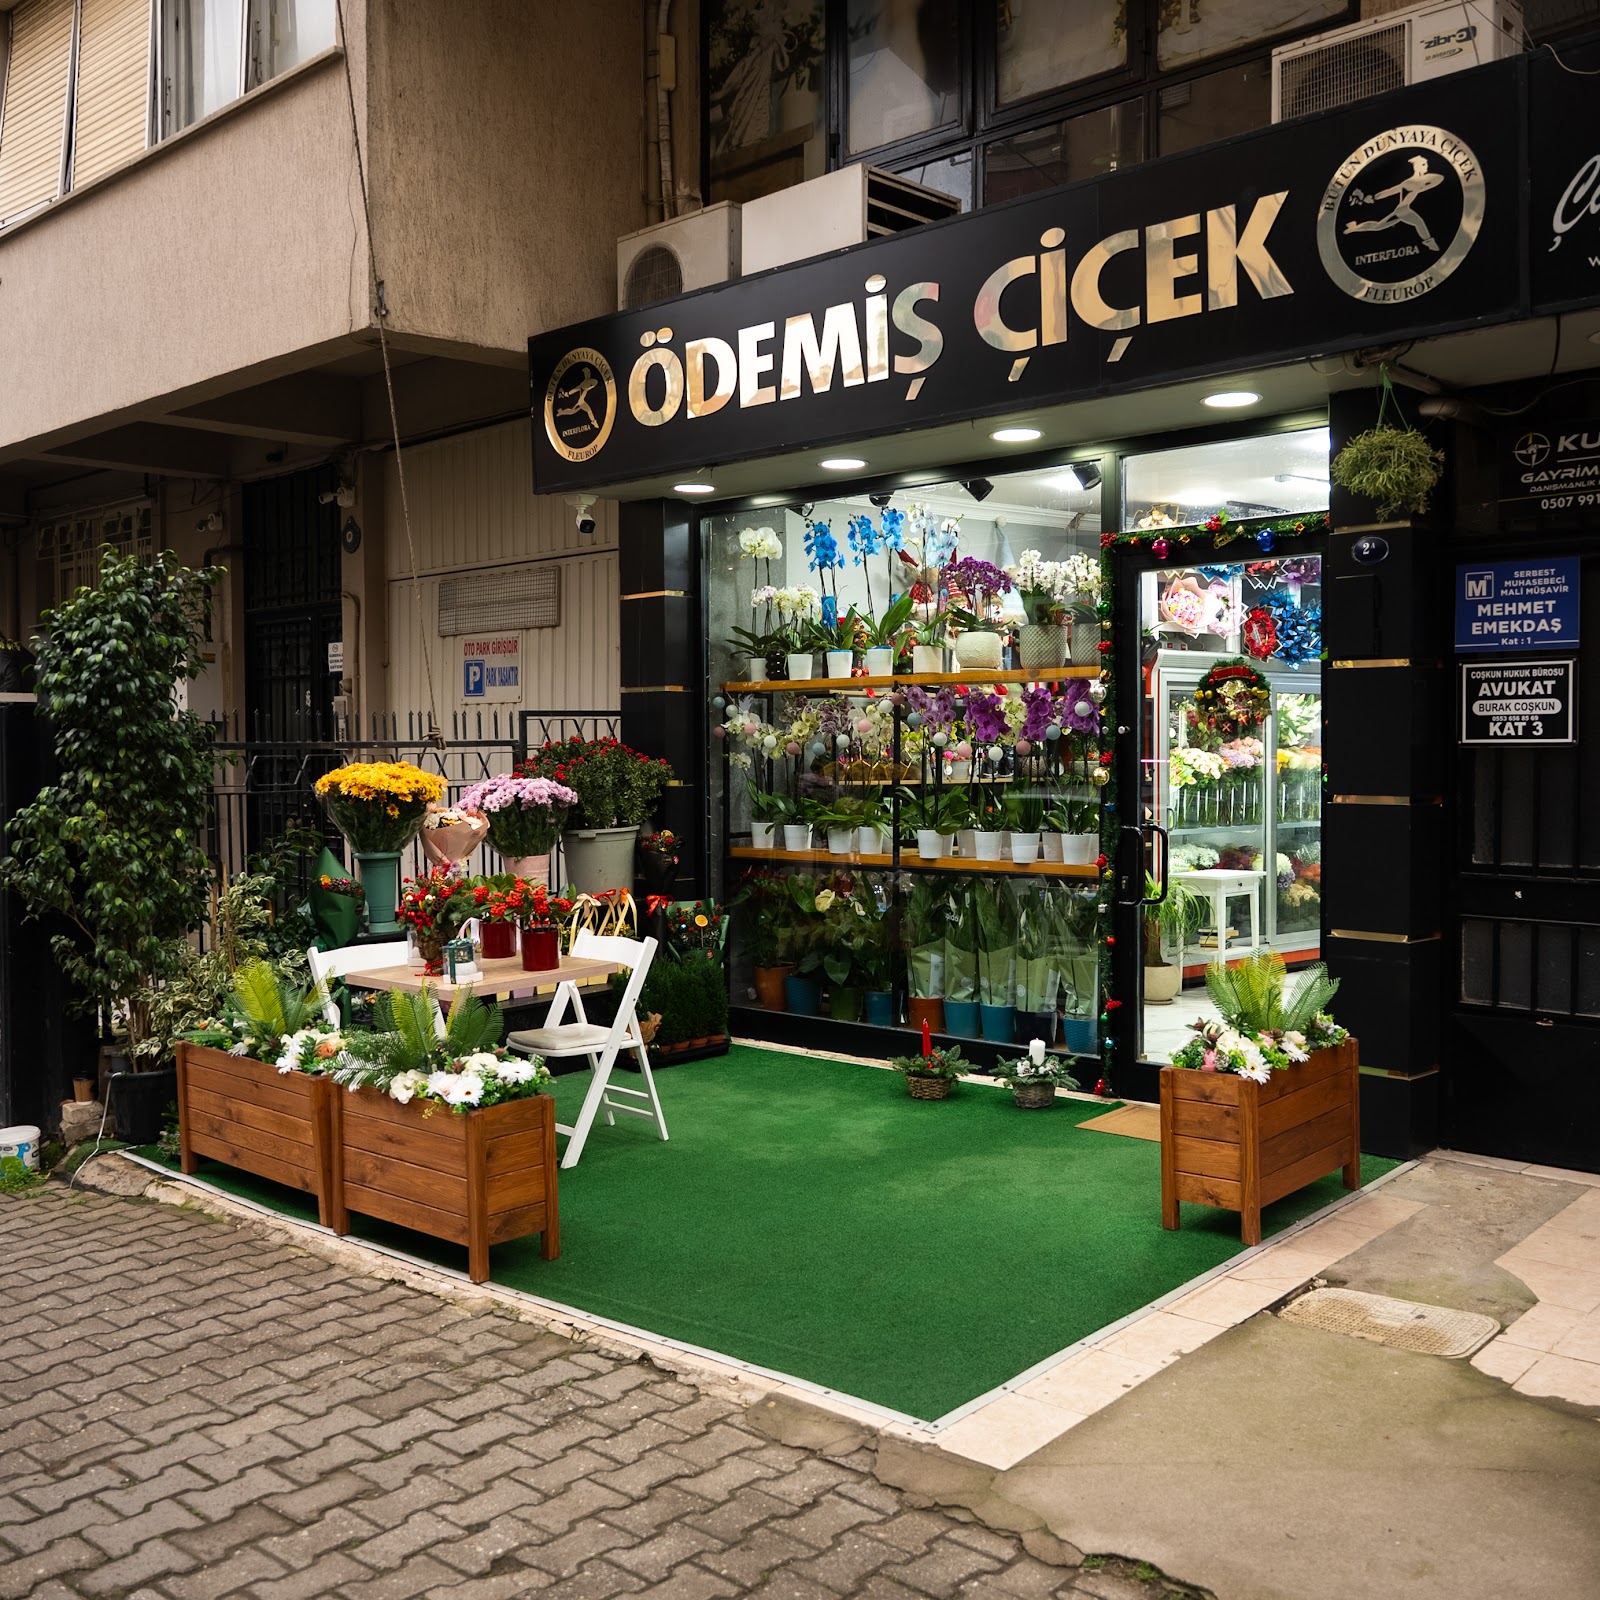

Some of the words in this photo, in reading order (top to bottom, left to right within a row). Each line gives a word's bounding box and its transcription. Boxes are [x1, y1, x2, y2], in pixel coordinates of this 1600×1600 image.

[1323, 156, 1361, 212] BÜTÜN
[1364, 129, 1436, 160] DÜNYAYA
[1440, 137, 1478, 182] ÇİÇEK
[1355, 245, 1420, 266] INTERFLORA
[1364, 276, 1434, 301] FLEUROP
[628, 274, 944, 427] ÖDEMİŞ
[974, 190, 1294, 382] ÇİÇEK
[562, 424, 591, 437] INTERFLORA
[567, 444, 598, 460] FLEUROP
[1541, 497, 1574, 509] 0507
[1578, 494, 1600, 506] 991
[1513, 568, 1556, 578] SERBEST
[1504, 575, 1566, 587] MUHASEBECİ
[1500, 587, 1524, 596] MALİ
[1525, 585, 1569, 595] MÜŞAVİR
[1477, 600, 1557, 617] MEHMET
[1471, 618, 1562, 635] EMEKDAŞ
[463, 642, 475, 656] OTO
[476, 641, 491, 655] PARK
[1501, 637, 1519, 646] Kat
[486, 667, 497, 687] PARK
[1470, 670, 1502, 680] COŞKUN
[1503, 669, 1531, 678] HUKUK
[1532, 667, 1564, 677] BÜROSU
[1478, 680, 1556, 697] AVUKAT
[1478, 702, 1512, 713] BURAK
[1514, 701, 1555, 713] COŞKUN
[1489, 721, 1527, 736] KAT
[1532, 721, 1544, 736] 3
